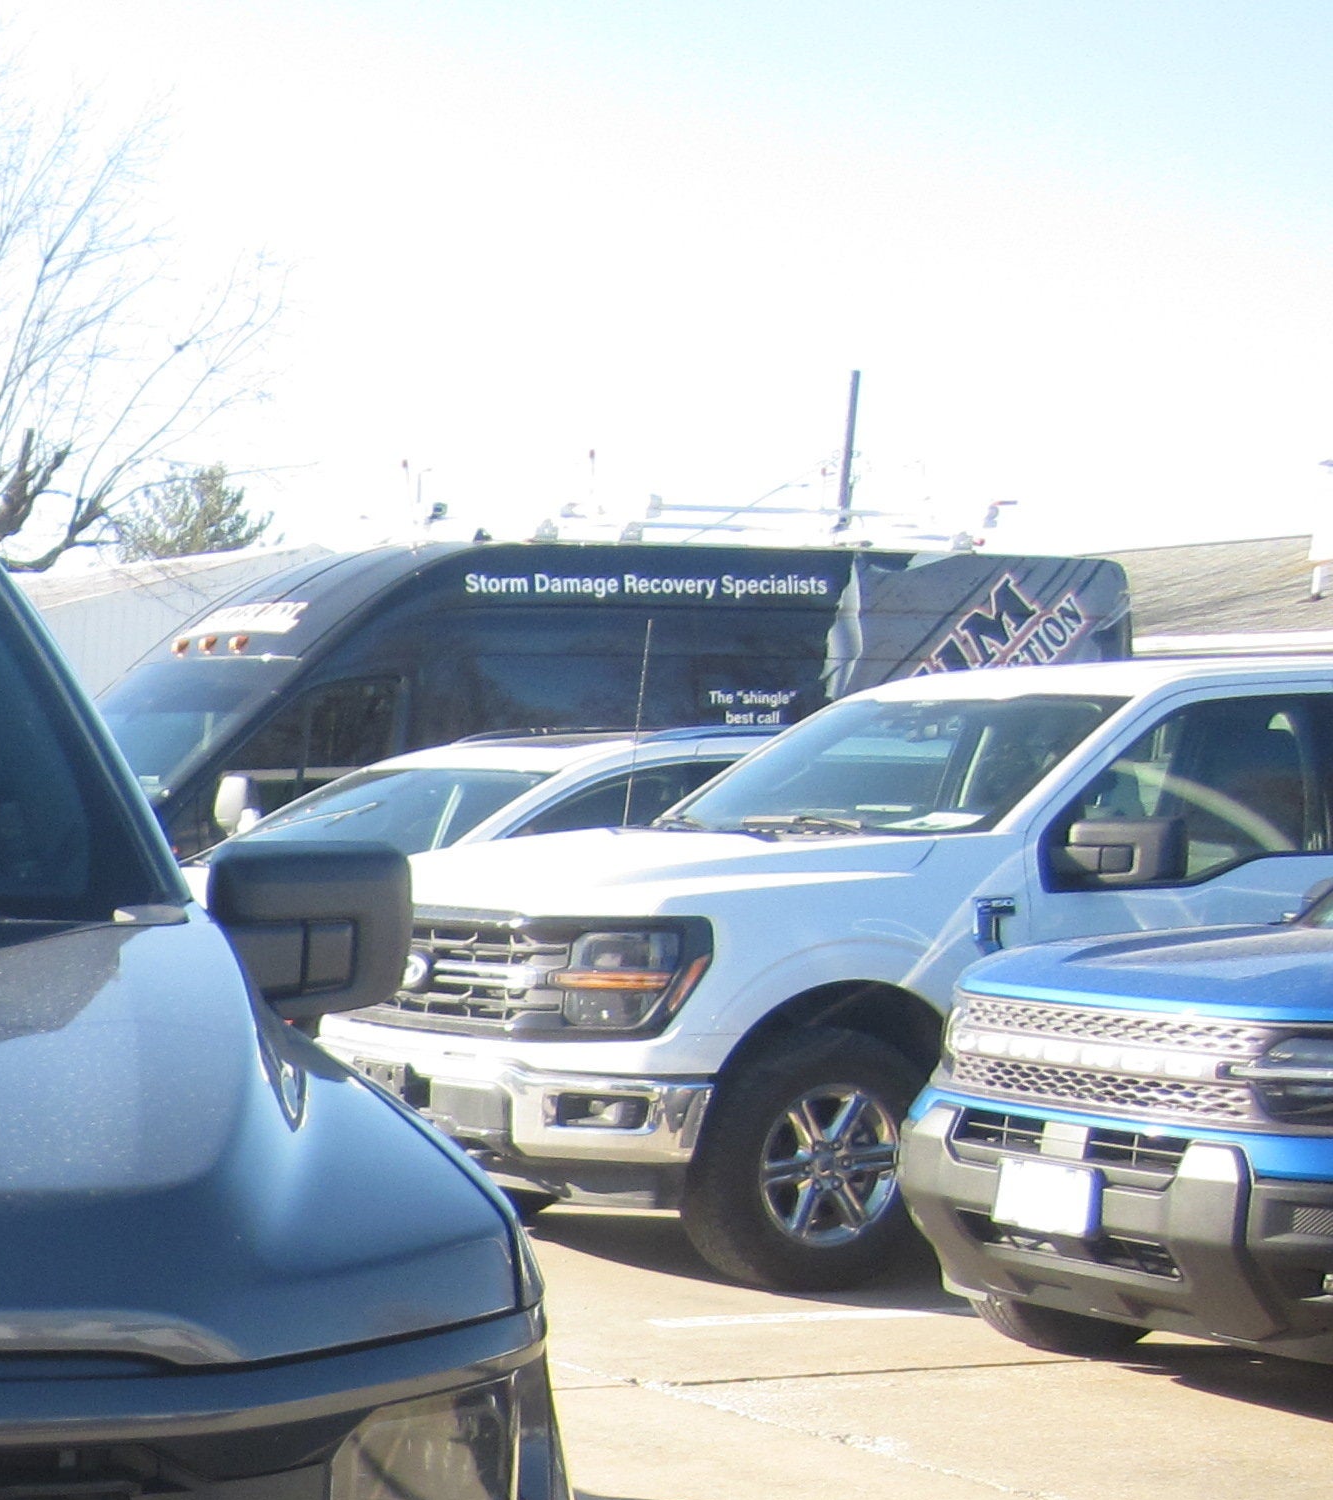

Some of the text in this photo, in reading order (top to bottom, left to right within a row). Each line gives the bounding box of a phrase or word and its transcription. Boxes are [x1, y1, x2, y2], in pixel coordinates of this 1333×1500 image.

[464, 573, 828, 599] Storm Damage Recovery Specialists
[709, 690, 797, 707] The "shingle"
[725, 711, 780, 724] best call
